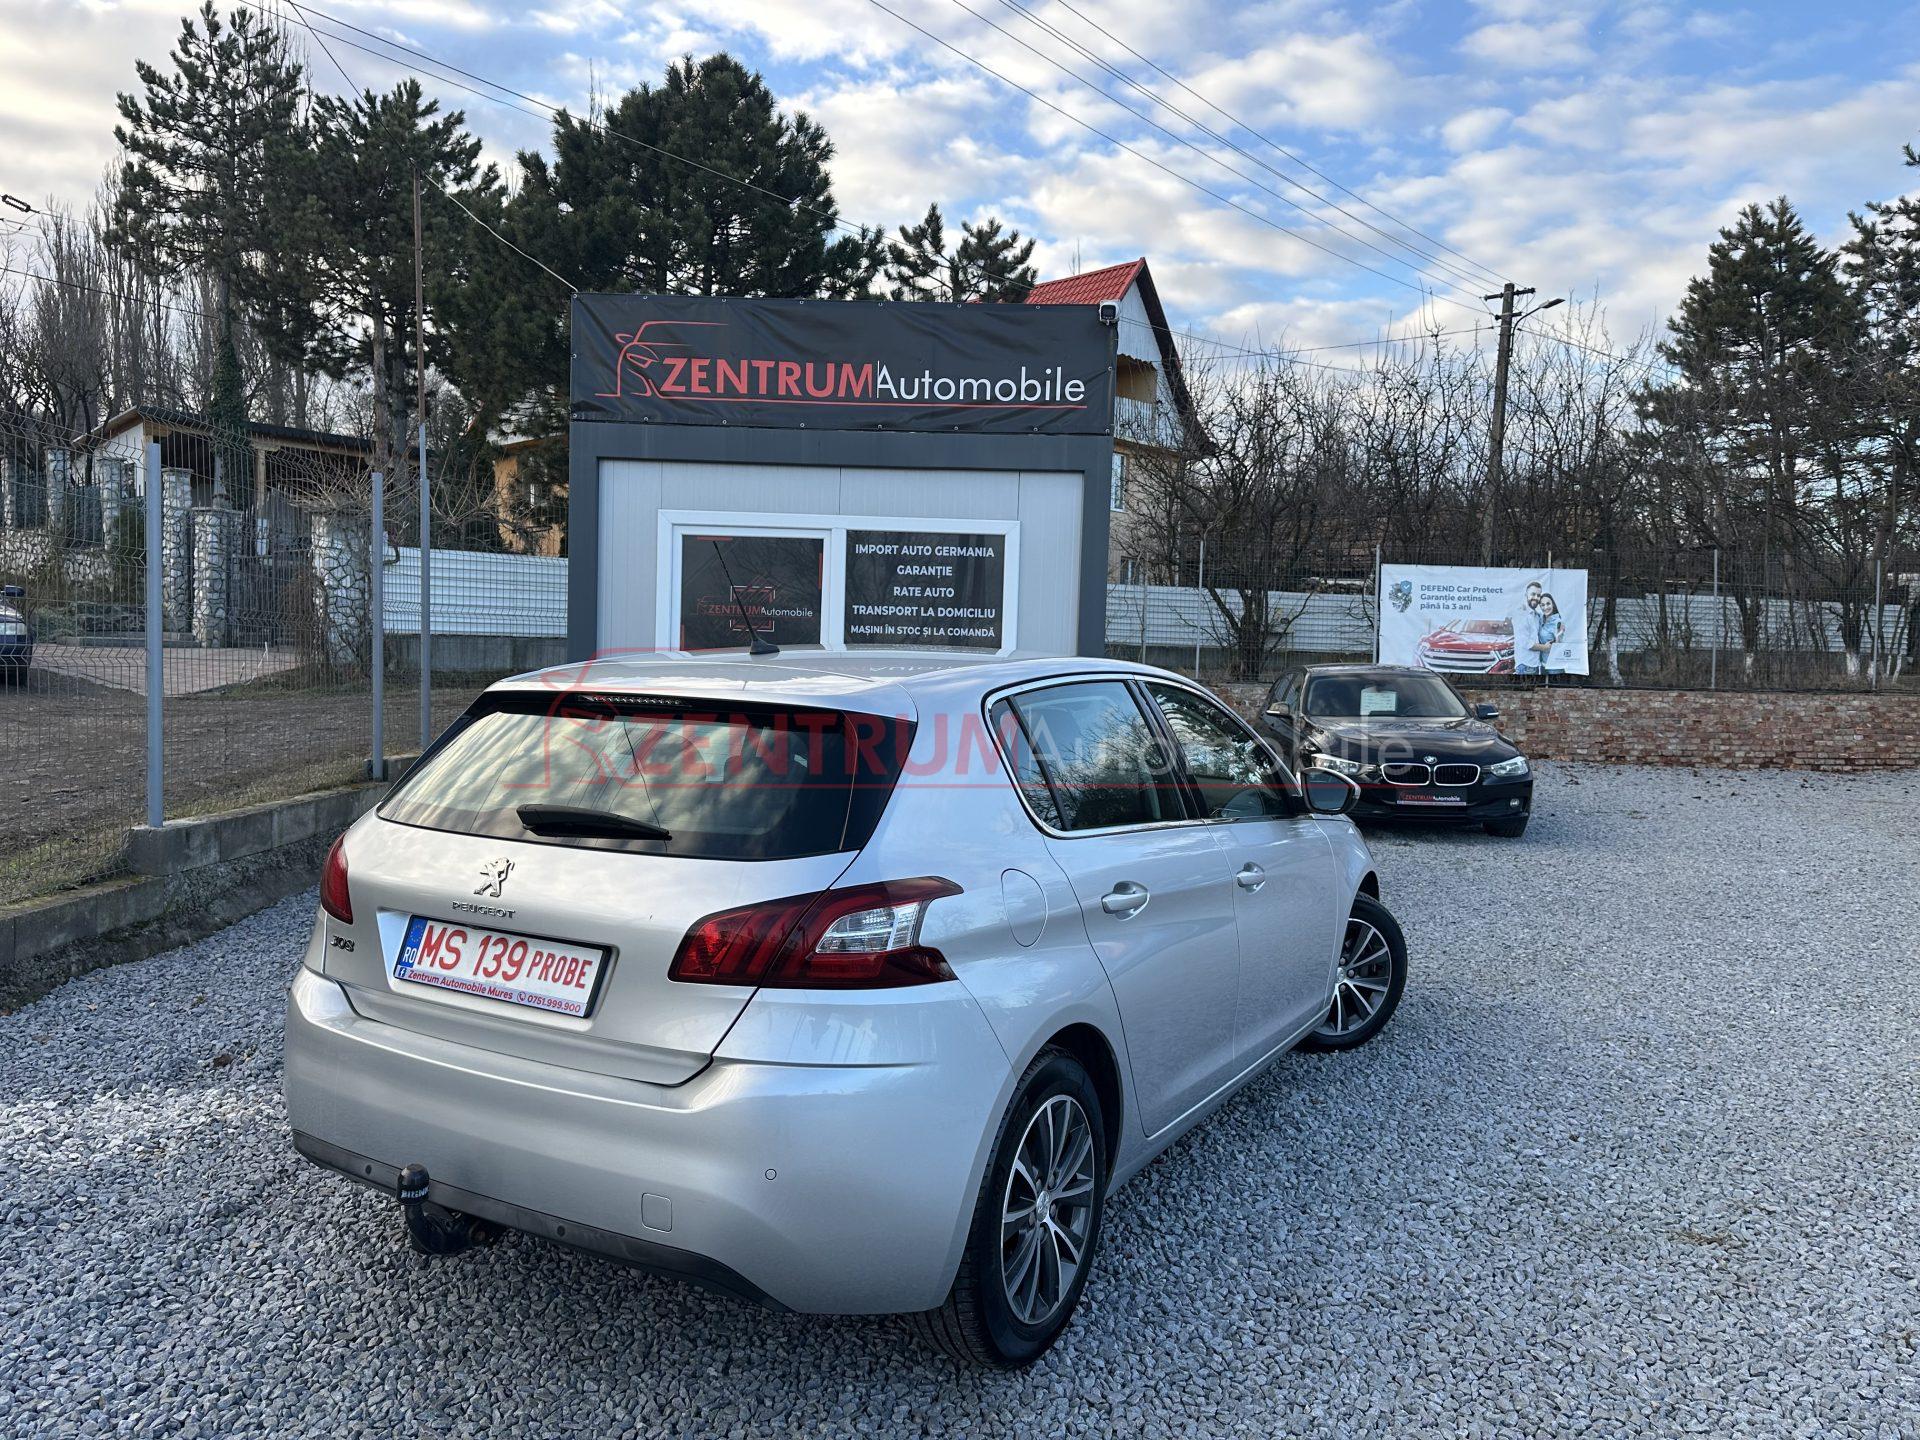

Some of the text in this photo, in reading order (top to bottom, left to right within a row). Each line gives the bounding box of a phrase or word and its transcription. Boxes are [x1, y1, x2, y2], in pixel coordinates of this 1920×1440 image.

[660, 357, 1085, 402] ZENTRUM Automobile
[855, 544, 995, 557] IMPORT AUTO GERMANIA
[896, 565, 953, 578] GARANȚIE
[893, 586, 955, 598] RATE AUTO
[1420, 584, 1503, 594] DEFEND Car Protect
[1420, 593, 1456, 602] Garanție
[760, 606, 813, 617] Automobile
[852, 605, 996, 618] TRANSPORT LA DOMICILIU
[1420, 602, 1441, 610] până
[850, 624, 995, 637] MAȘINI ÎN STOC ȘI LA COMANDĂ
[452, 901, 516, 919] PEUGEOT
[330, 935, 355, 952] 308
[403, 946, 417, 963] RO
[417, 925, 593, 989] MS 139 PROBE
[408, 970, 440, 984] Zentrum
[439, 977, 487, 994] Automobile
[487, 986, 514, 1000] Mures
[527, 994, 581, 1013] 0751.999.900
